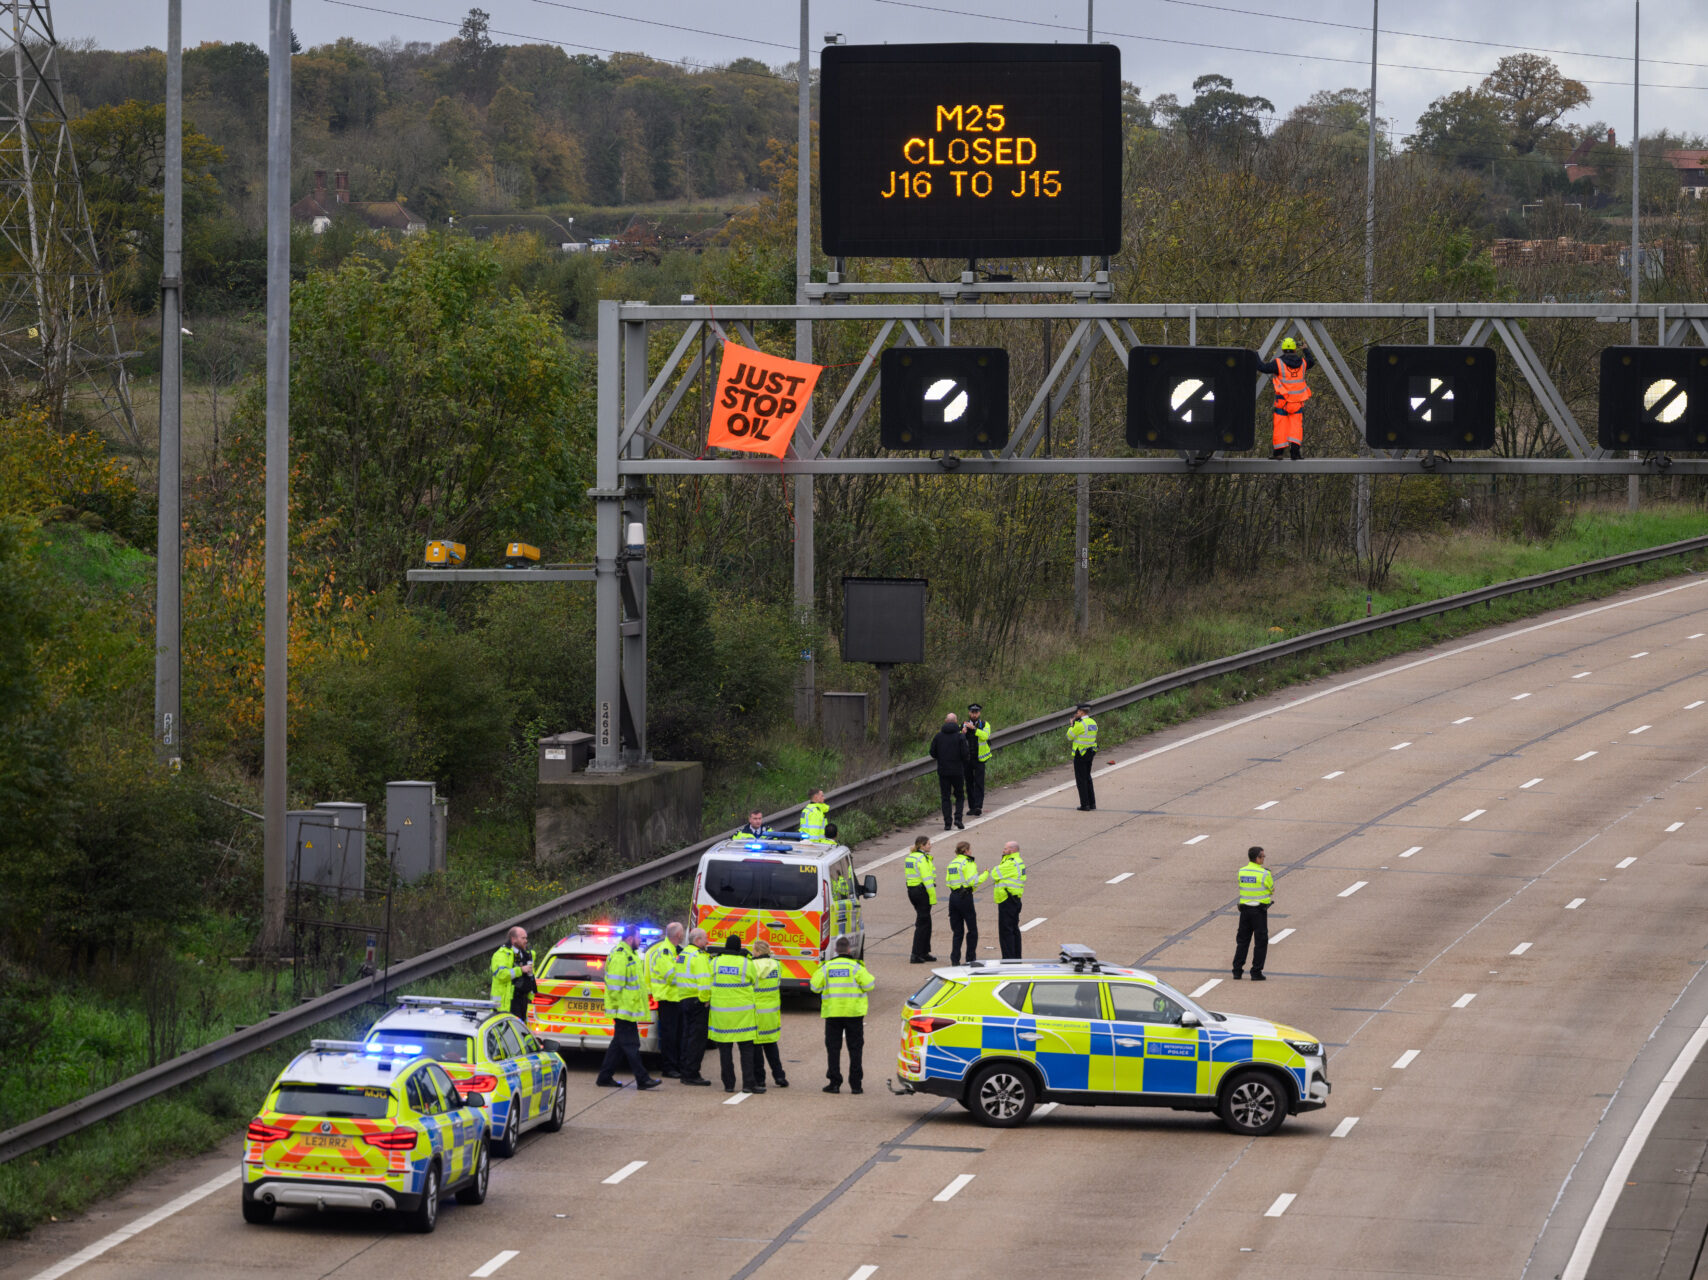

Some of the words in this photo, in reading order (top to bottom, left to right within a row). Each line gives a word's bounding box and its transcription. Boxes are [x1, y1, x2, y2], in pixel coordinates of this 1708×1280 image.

[936, 104, 1005, 132] M25
[903, 137, 1037, 165] CLOSED
[881, 170, 932, 198] J16
[949, 170, 993, 198] TO
[1011, 170, 1062, 198] J15
[727, 363, 806, 396] JUST
[720, 385, 797, 419] STOP
[727, 412, 771, 442] OIL
[799, 865, 817, 874] LKN
[771, 933, 806, 944] POLICE
[719, 966, 739, 975] POLICE
[275, 1162, 376, 1175] POLICE
